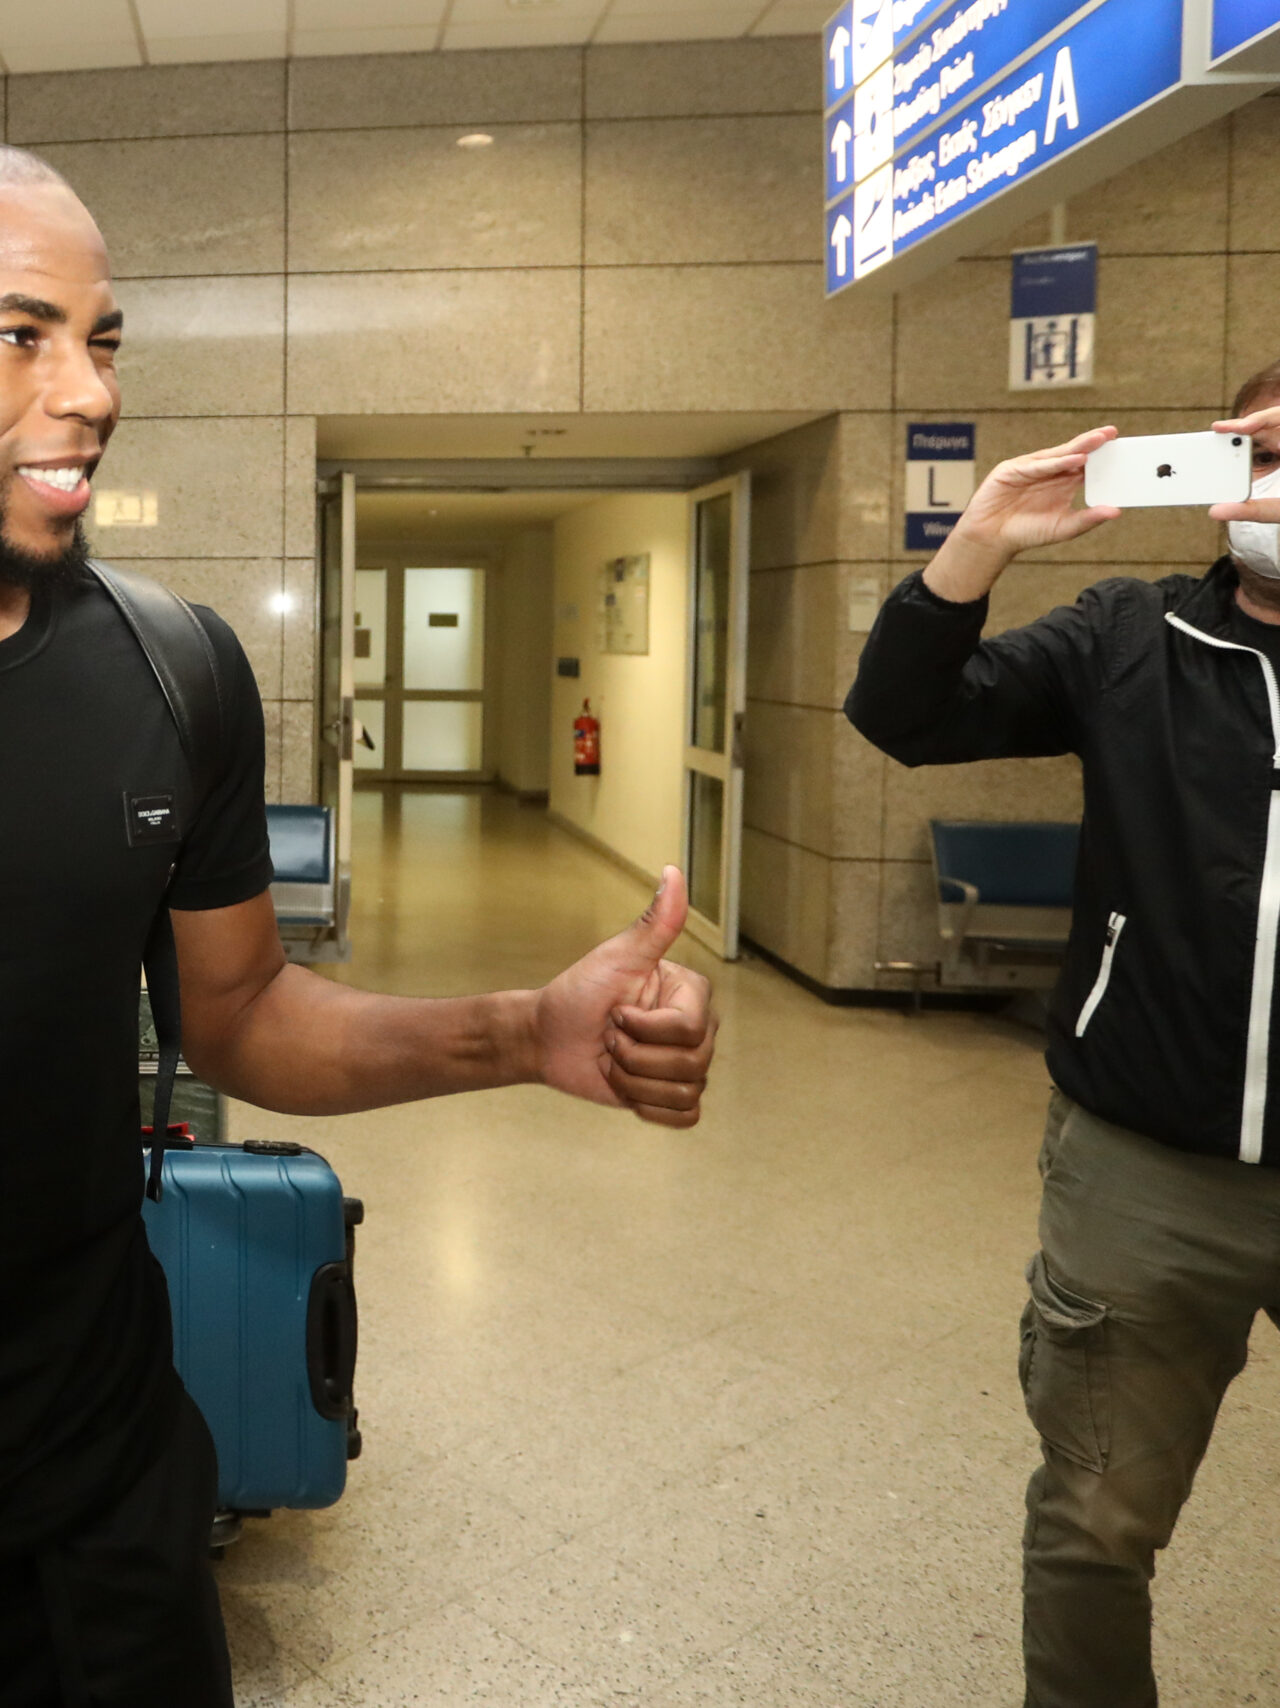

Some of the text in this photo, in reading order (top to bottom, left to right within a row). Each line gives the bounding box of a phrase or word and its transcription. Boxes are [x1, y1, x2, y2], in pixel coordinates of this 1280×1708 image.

[940, 51, 974, 99] Point
[1044, 46, 1079, 146] A
[967, 130, 1036, 193] Schengen
[929, 466, 950, 507] L
